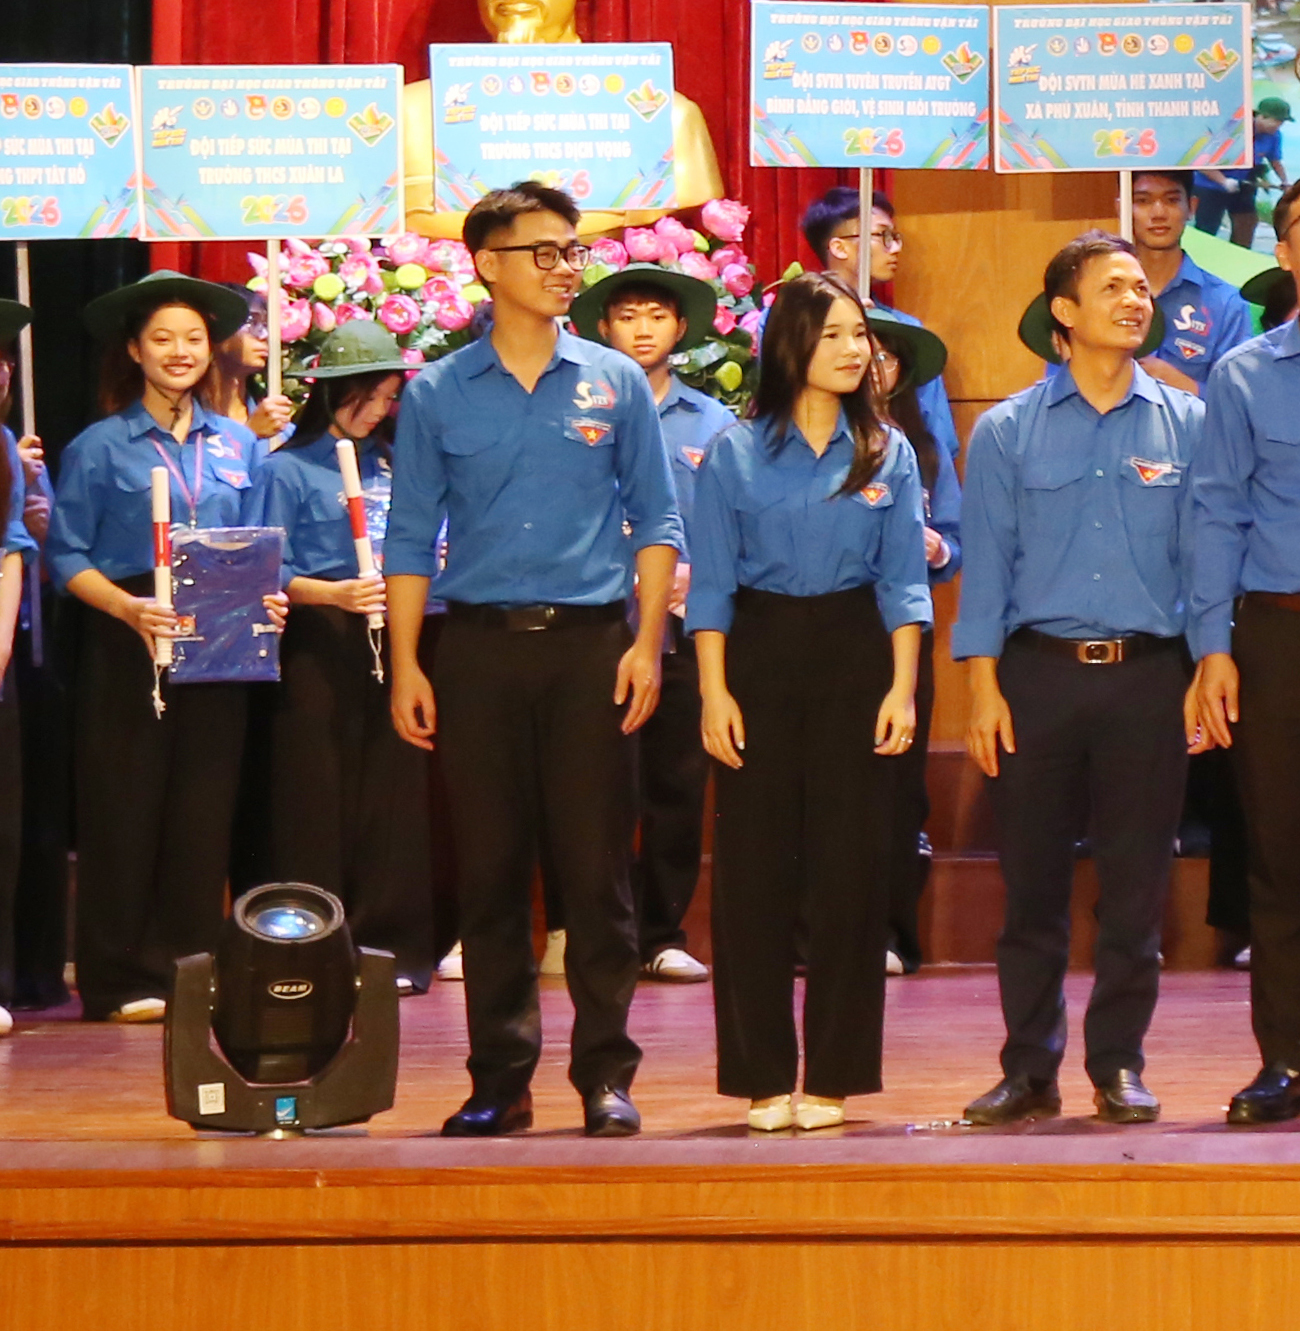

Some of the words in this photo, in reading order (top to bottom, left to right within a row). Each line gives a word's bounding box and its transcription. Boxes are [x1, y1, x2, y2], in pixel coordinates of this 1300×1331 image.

[792, 71, 813, 92] ĐỘI
[816, 74, 843, 89] SVTN
[925, 76, 951, 91] ATGT
[1038, 73, 1062, 95] ĐỘI
[1065, 74, 1095, 90] SVTN
[1099, 72, 1127, 90] MÙA
[1149, 74, 1182, 89] XANH
[1185, 73, 1205, 93] TẠI
[862, 98, 876, 118] VỆ
[878, 101, 904, 115] SINH
[1148, 102, 1188, 117] THANH
[843, 127, 905, 157] 2026
[1093, 128, 1158, 157] 2026
[240, 194, 309, 225] 2026
[273, 985, 308, 993] BEAM
